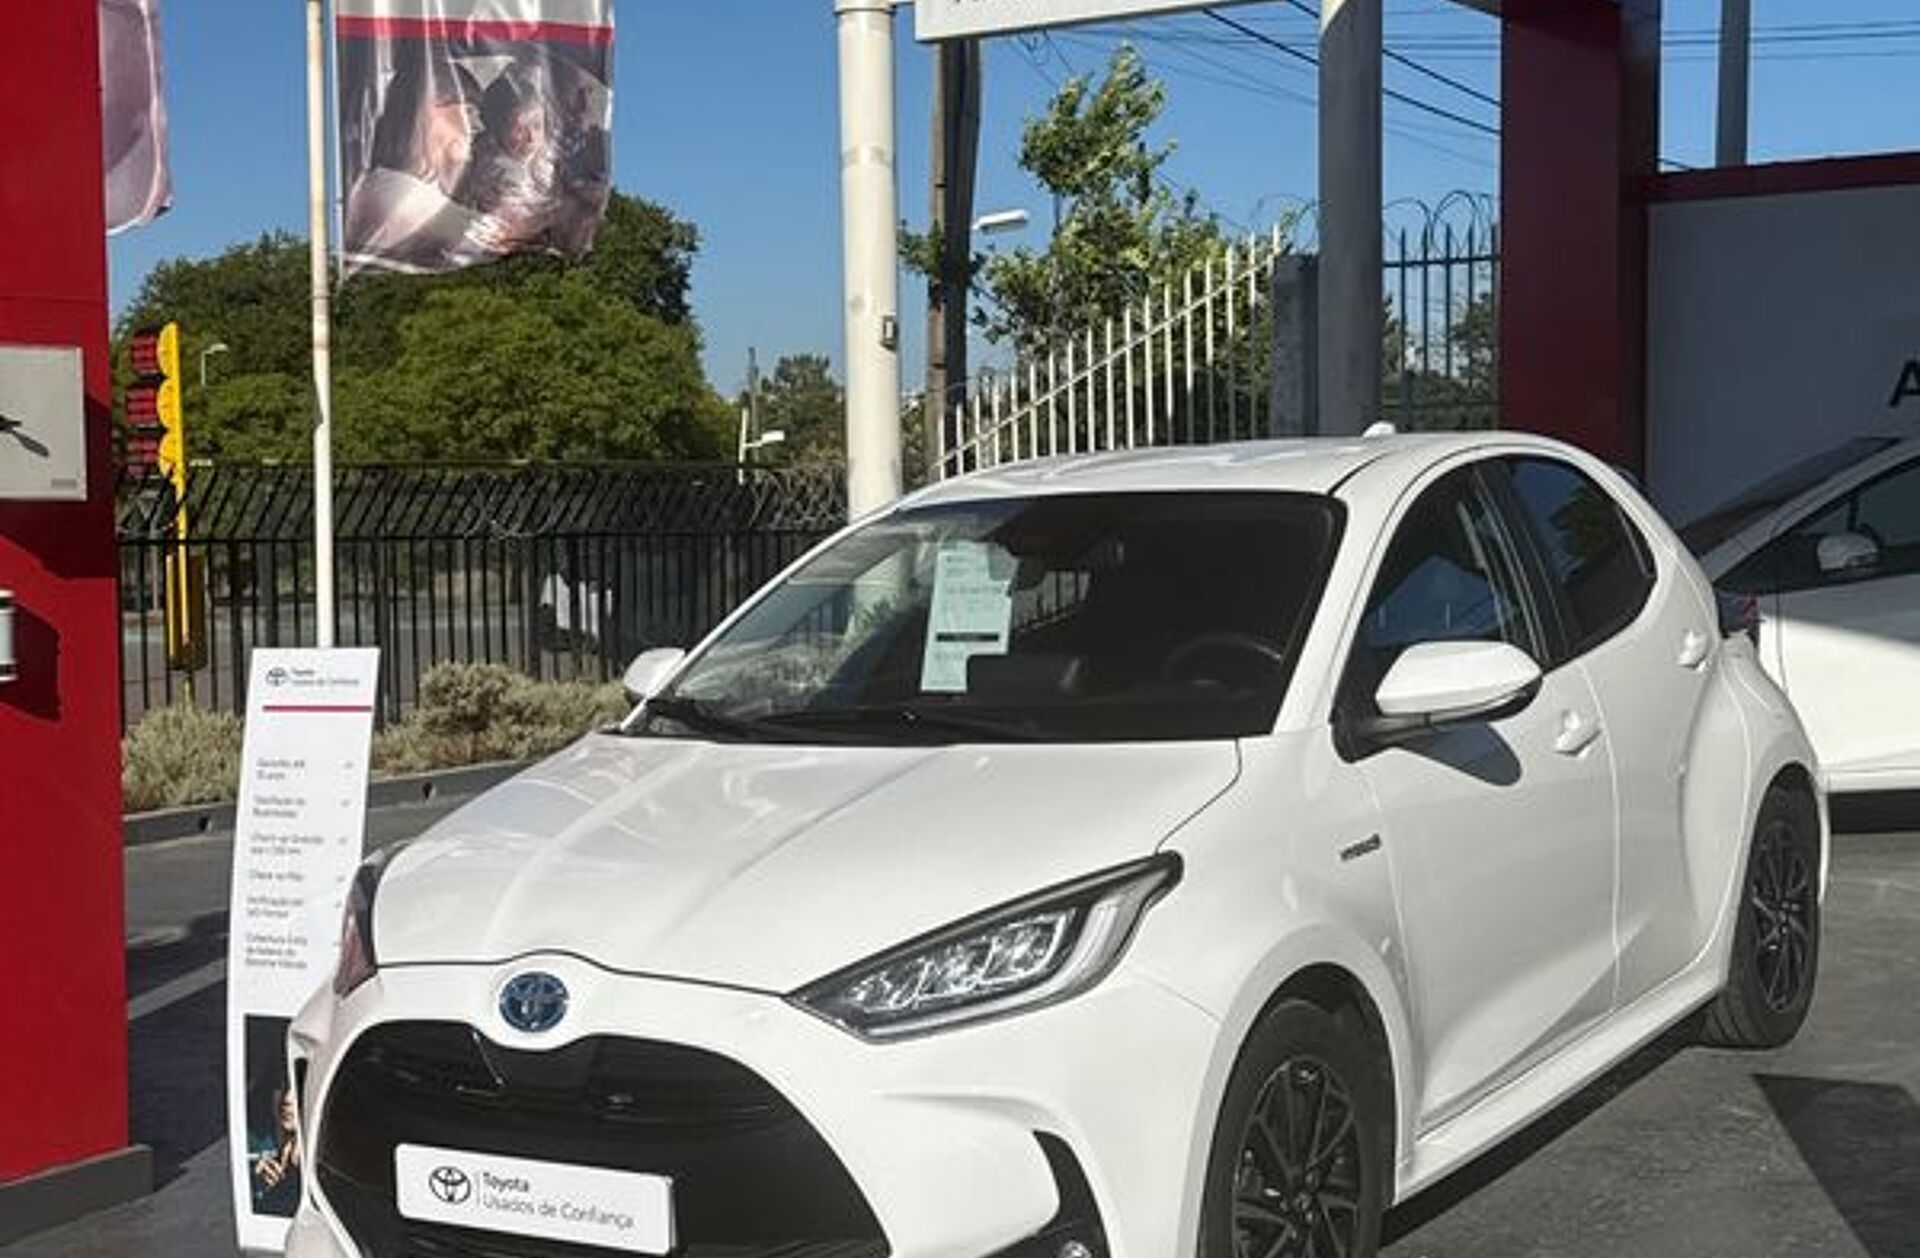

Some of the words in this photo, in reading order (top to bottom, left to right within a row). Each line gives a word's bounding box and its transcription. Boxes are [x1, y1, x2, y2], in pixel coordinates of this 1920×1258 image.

[483, 1172, 529, 1192] Toyota
[483, 1194, 534, 1214] Usados
[538, 1201, 557, 1217] de
[560, 1202, 634, 1230] Confiança
